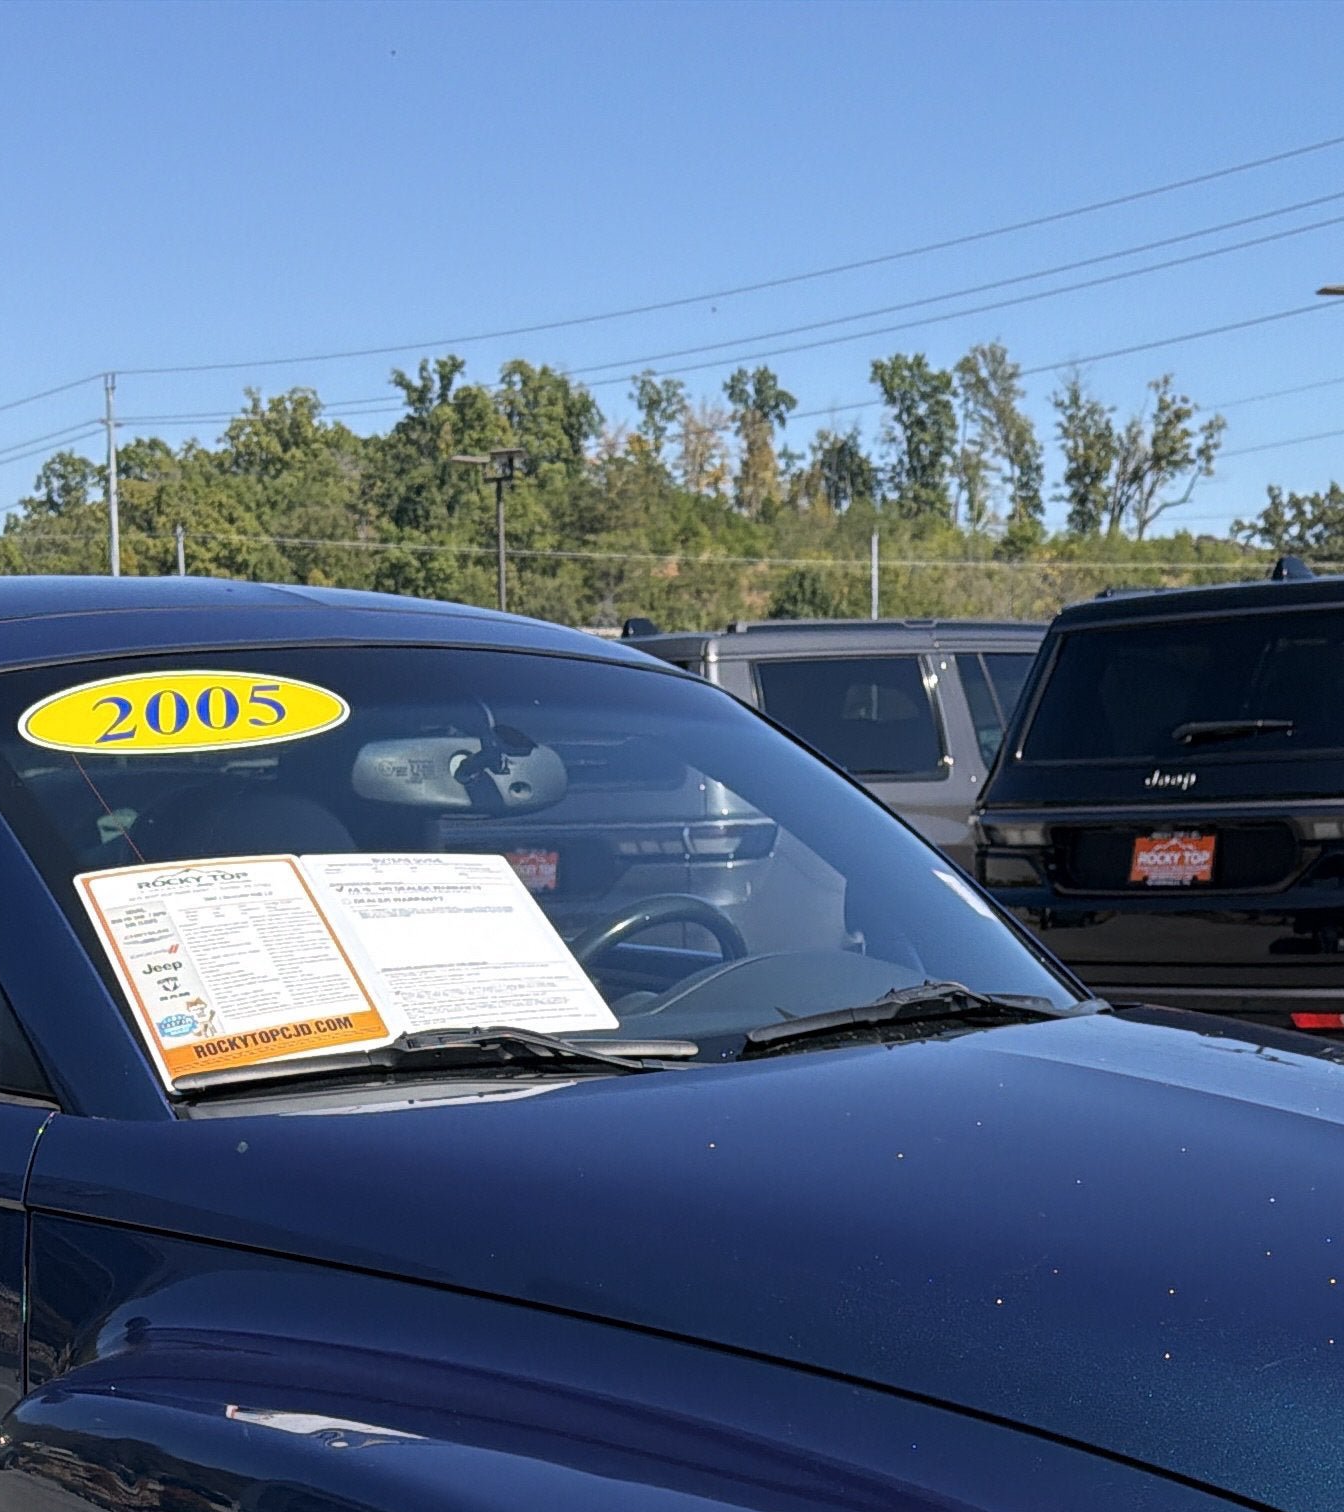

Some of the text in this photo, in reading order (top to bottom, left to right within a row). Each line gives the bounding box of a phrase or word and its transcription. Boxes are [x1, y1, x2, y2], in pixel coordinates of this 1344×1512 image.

[92, 684, 286, 744] 2005
[137, 873, 202, 890] ROCKY
[207, 871, 249, 882] TOP
[142, 960, 183, 975] Jeep
[194, 1016, 353, 1059] ROCKYTOPCJD.COM
